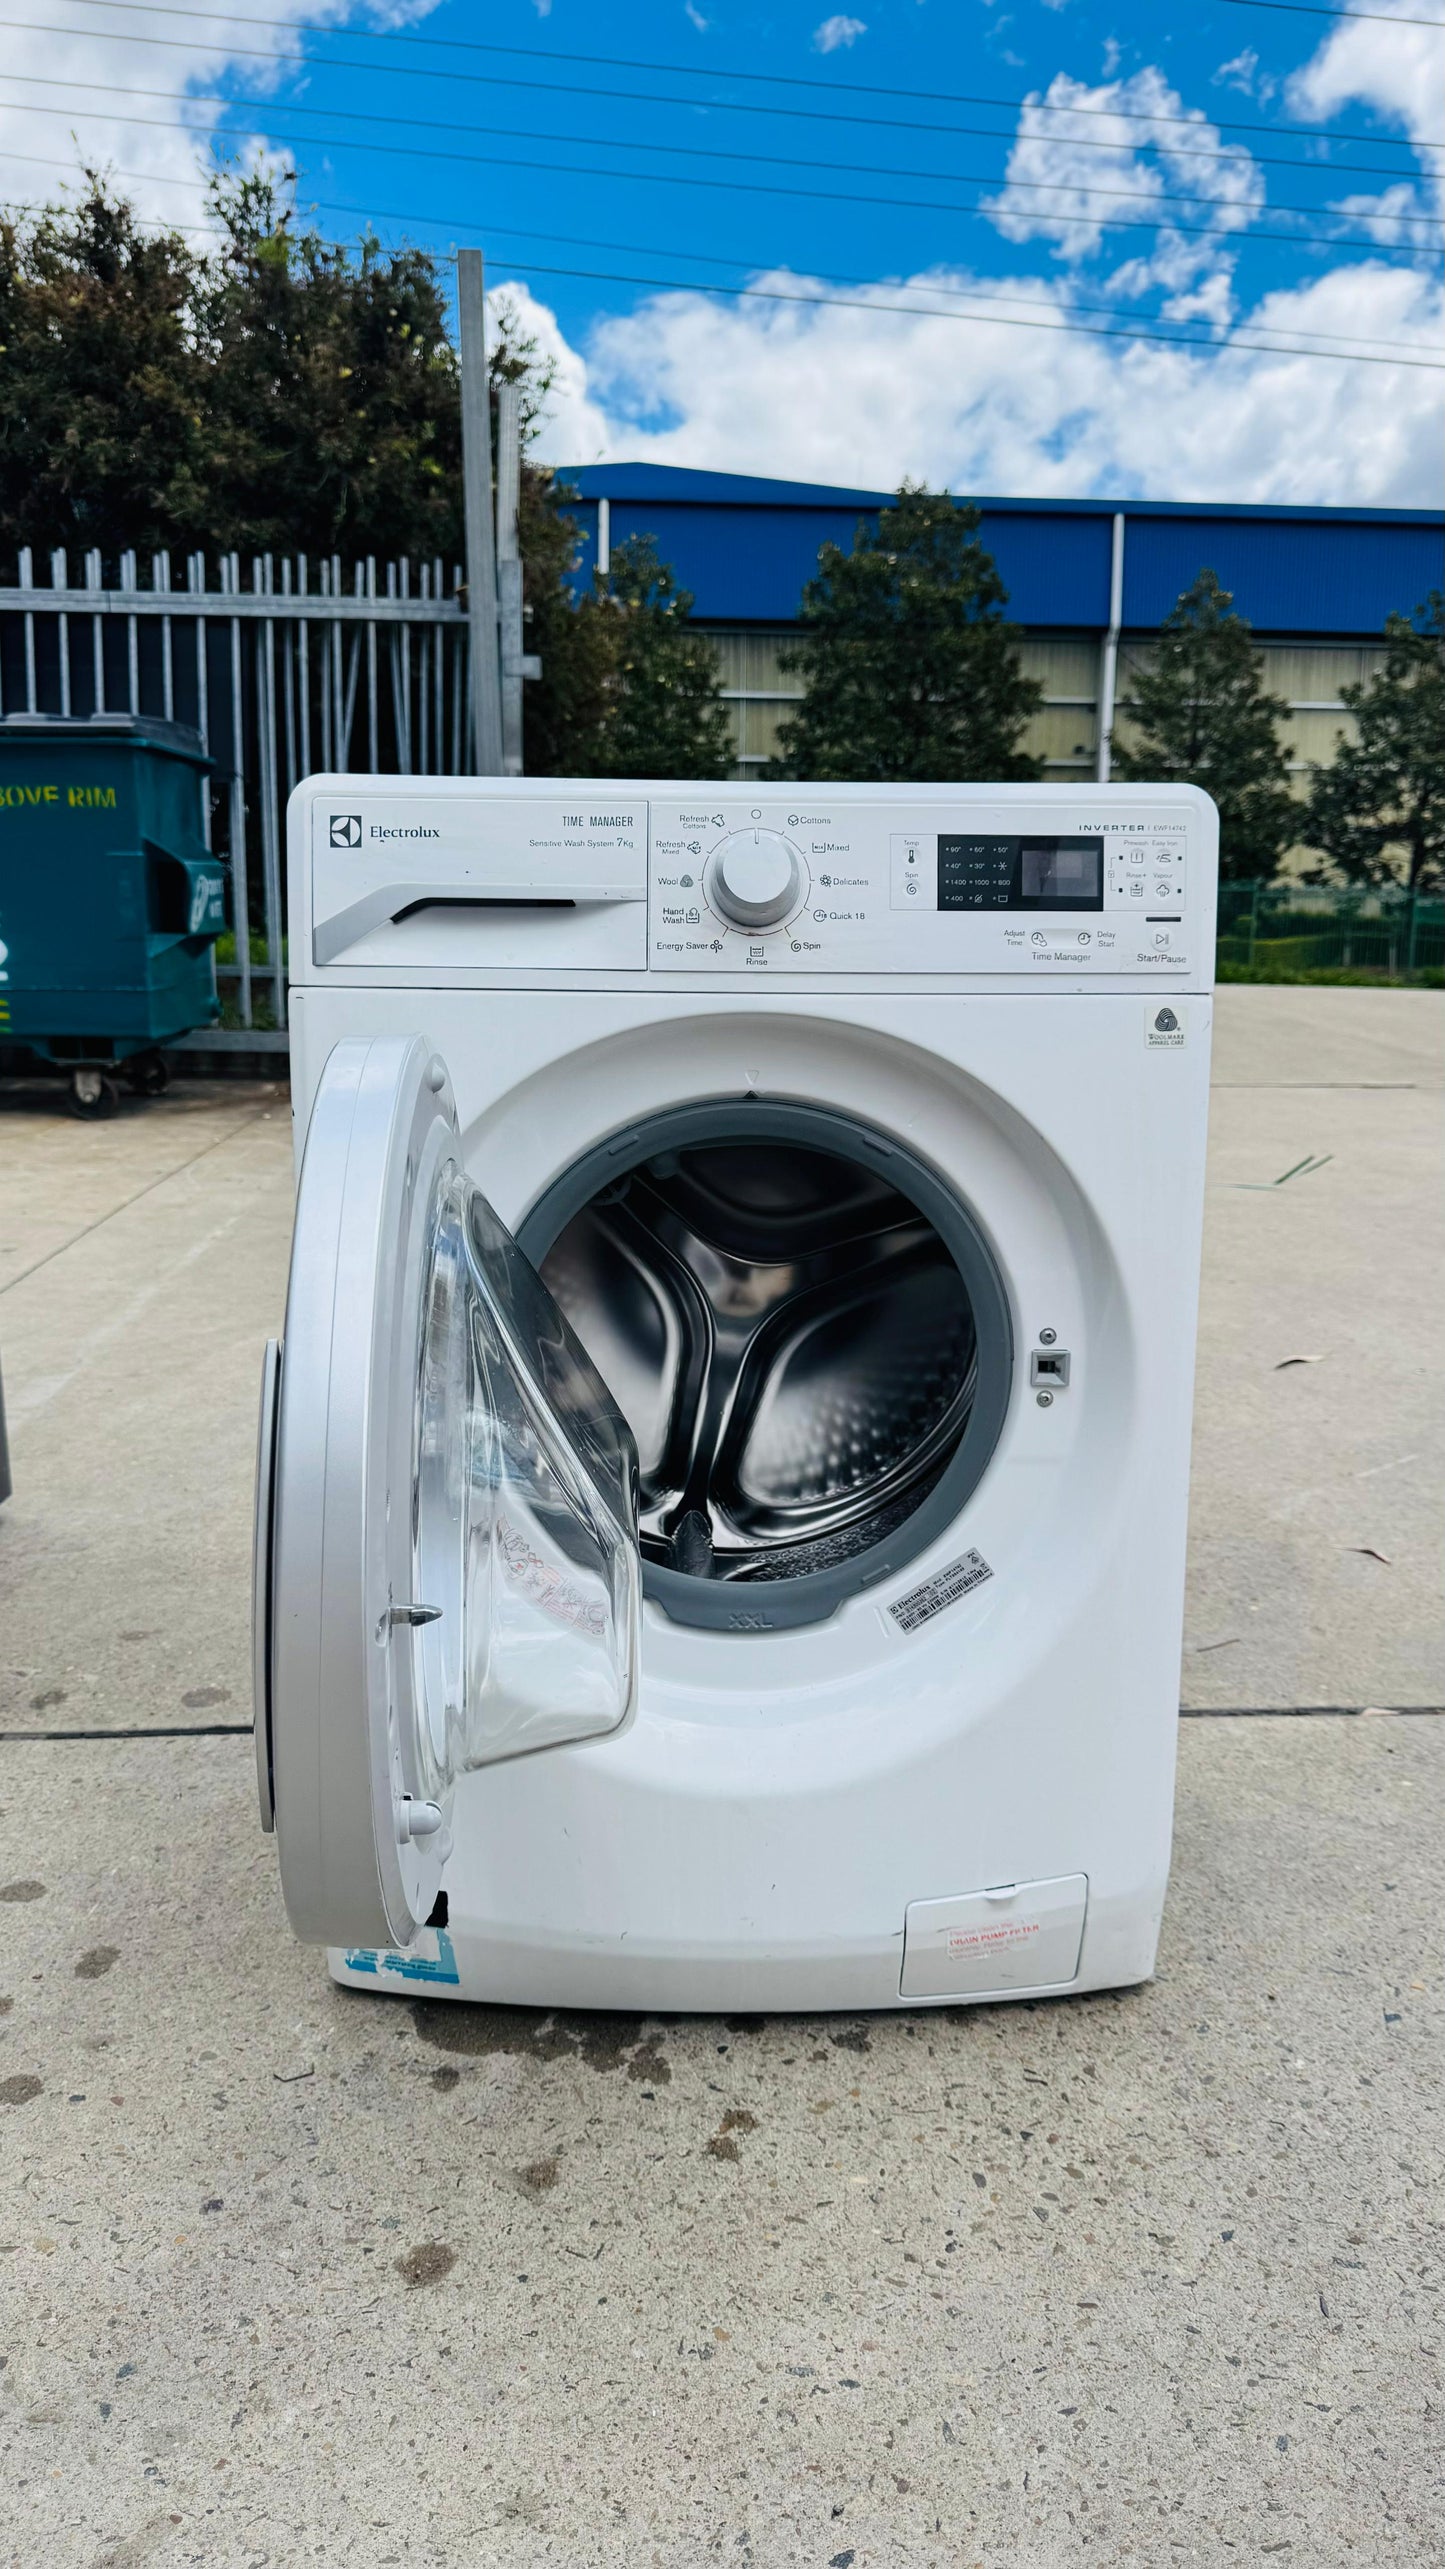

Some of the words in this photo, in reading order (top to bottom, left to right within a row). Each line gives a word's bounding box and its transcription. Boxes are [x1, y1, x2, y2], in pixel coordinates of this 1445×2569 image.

[68, 786, 116, 808] RIM
[562, 816, 584, 827] TIME
[590, 816, 634, 827] MANAGER
[679, 814, 710, 823] Refresh
[801, 816, 831, 825] Cottons
[682, 822, 706, 830] Cottons
[1078, 824, 1145, 832] INVERTER
[370, 825, 440, 838] Electrolux
[529, 839, 562, 848] Sensitive
[564, 839, 585, 848] Wash
[587, 839, 614, 849] System
[655, 840, 686, 848] Refresh
[826, 843, 850, 852] Mixed
[658, 878, 679, 886] Wool
[833, 877, 869, 887] Delicates
[997, 879, 1011, 887] 800
[662, 907, 685, 916] Hand
[829, 912, 853, 920] Quick
[855, 912, 866, 920] 18
[662, 916, 685, 925] Wash
[1003, 929, 1026, 938] Adjust
[1097, 930, 1116, 940] Delay
[656, 942, 684, 952] Energy
[686, 942, 708, 950] Saver
[803, 942, 821, 950] Spin
[1098, 940, 1115, 948] Start
[746, 958, 768, 966] Rinse
[1032, 952, 1052, 961] Time
[1054, 952, 1092, 963] Manager
[1136, 953, 1187, 964] Start/Pause
[897, 1585, 932, 1610] Electrolux
[728, 1611, 773, 1629] XXL
